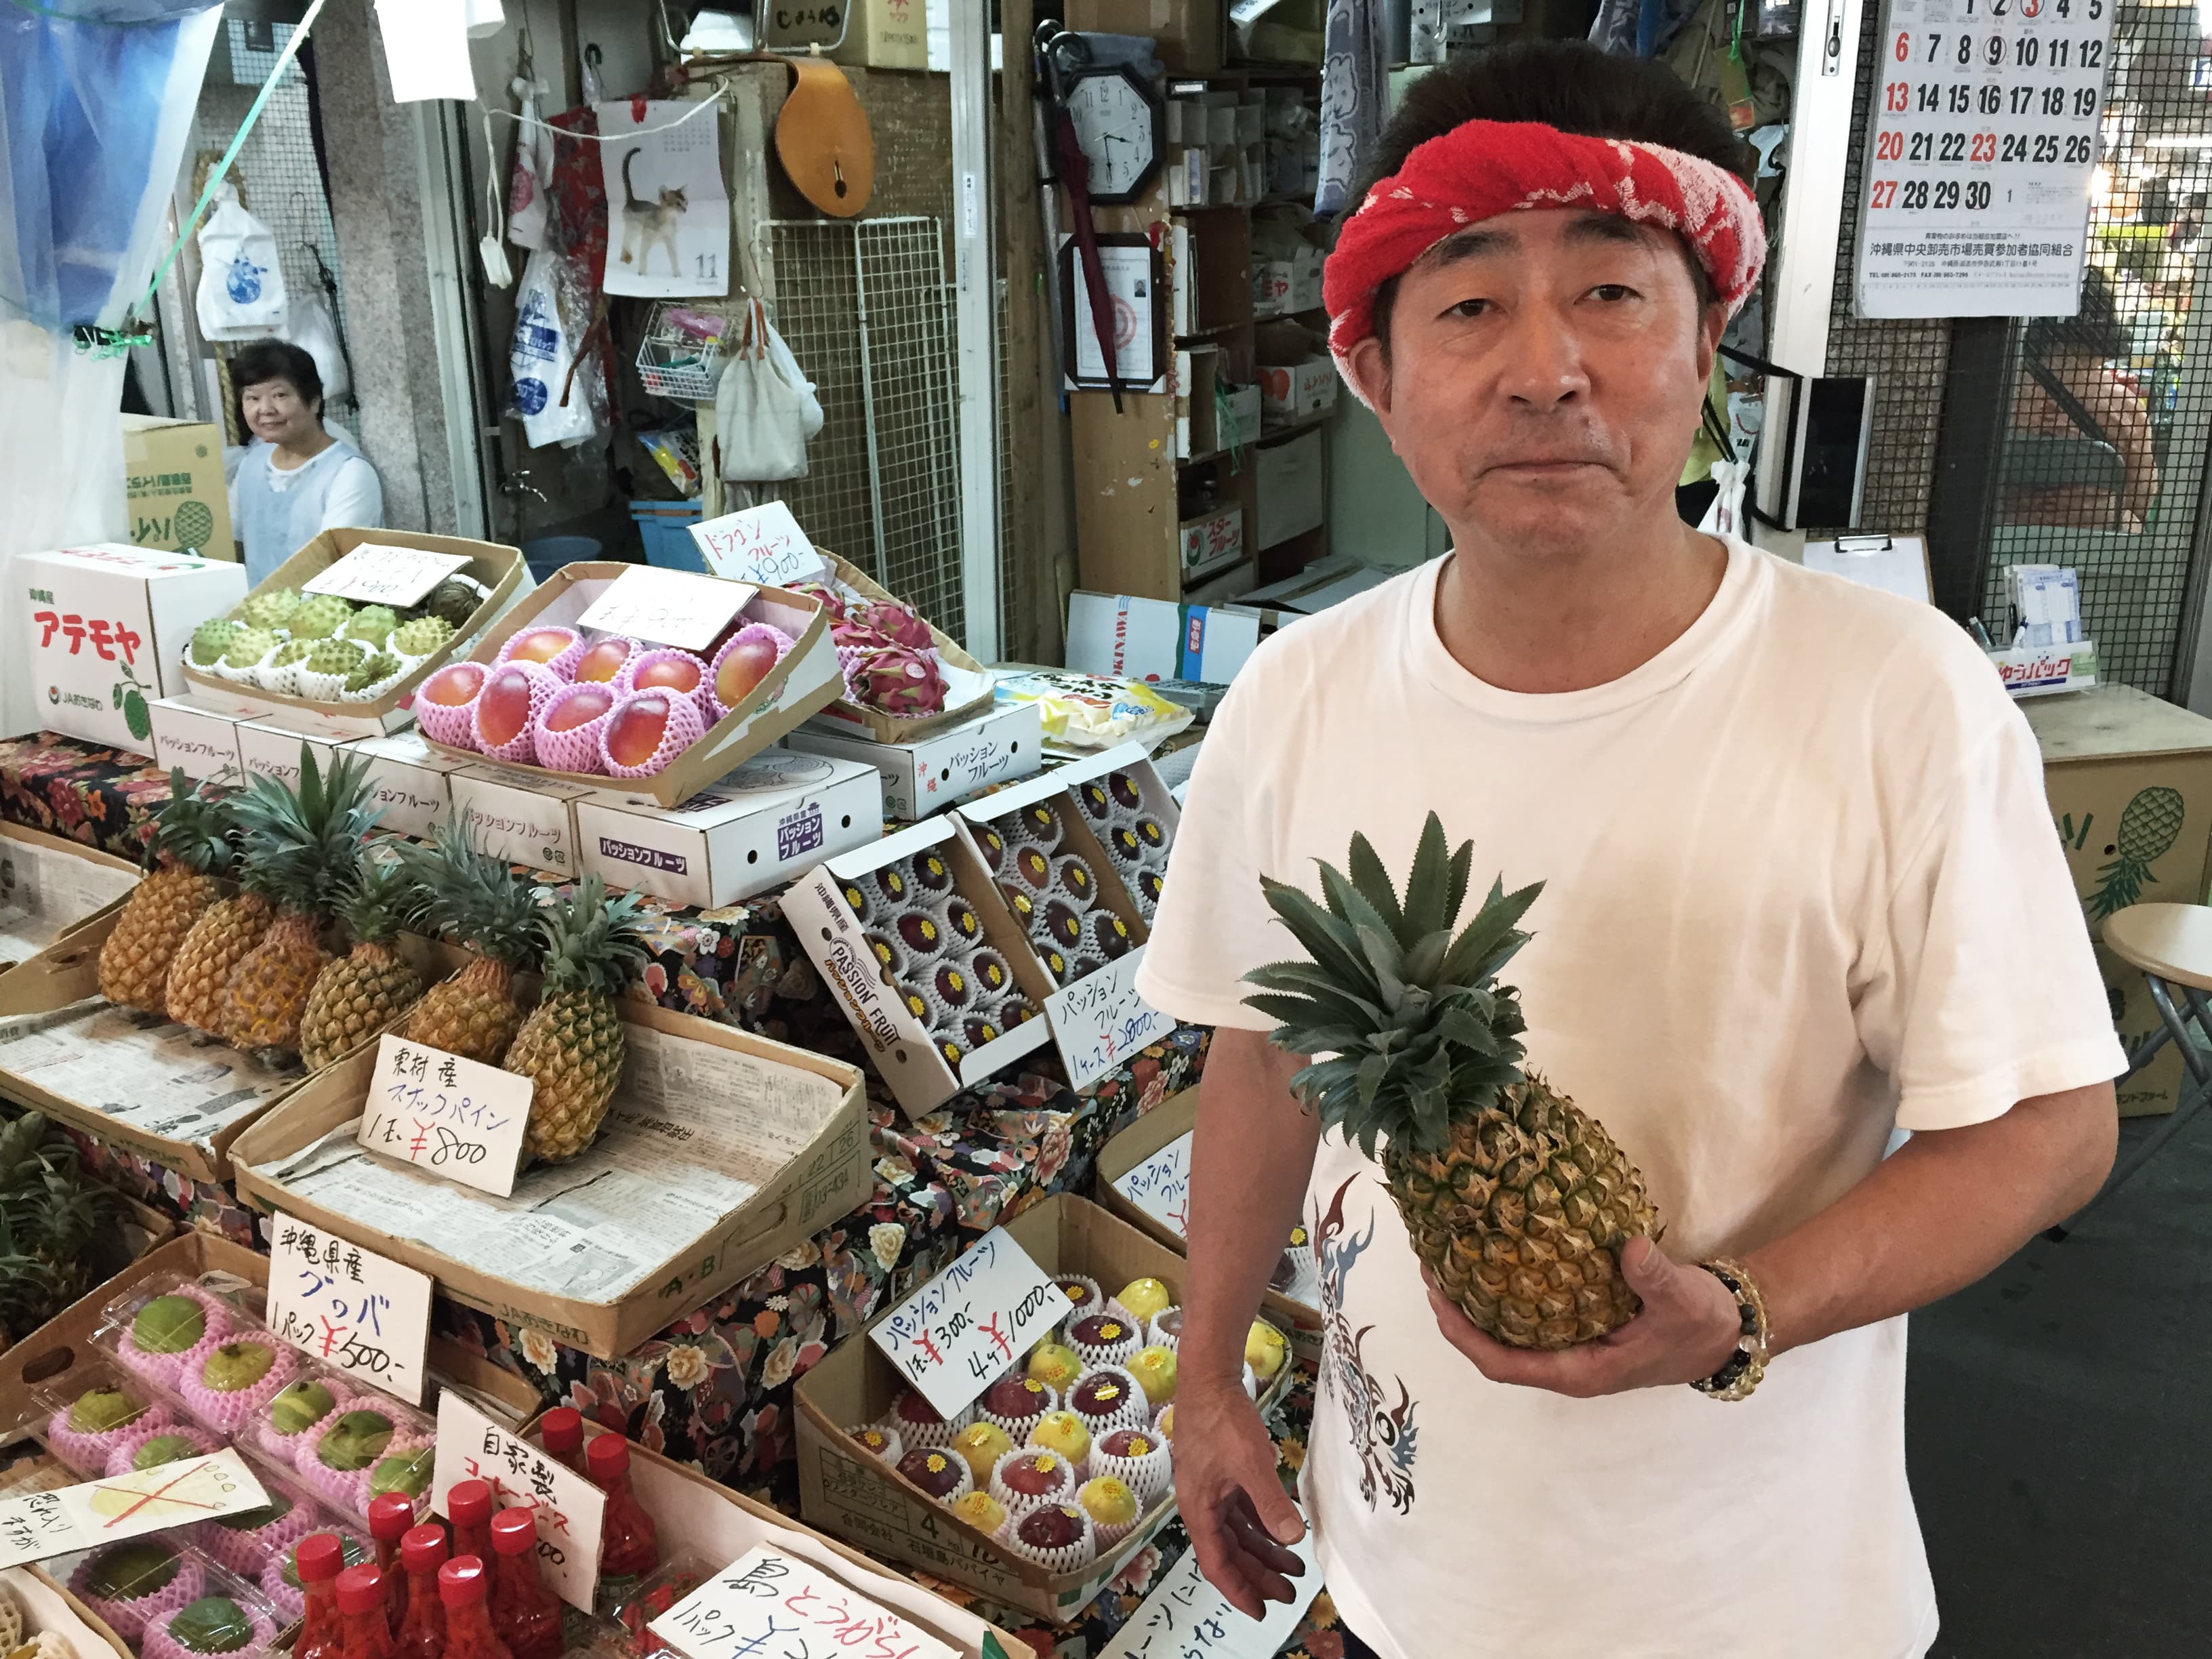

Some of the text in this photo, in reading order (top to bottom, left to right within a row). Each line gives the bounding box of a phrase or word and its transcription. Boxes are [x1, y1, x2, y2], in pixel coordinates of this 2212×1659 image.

[1896, 32, 2103, 68] 6 7 8 9 10 11 12
[1887, 82, 2097, 116] 13 14 15 16 17 18 19
[1877, 131, 2091, 163] 20 21 22 23 24 25 26
[1871, 180, 1898, 209] 27
[1902, 180, 1929, 209] 28
[1933, 181, 1960, 209] 29
[1965, 181, 1991, 210] 30
[1869, 243, 2074, 257] 沖縄県中央卸売市場売買参加者協同組合
[695, 253, 718, 279] 11
[1208, 518, 1231, 537] スター
[1208, 527, 1240, 556] フルーツ
[34, 611, 142, 665] アテモヤ
[1999, 657, 2072, 682] ゆうパック
[160, 735, 235, 761] パッションフルーツ
[949, 741, 998, 770] パッション
[968, 754, 1010, 783] フルーツ
[779, 817, 820, 844] パッション
[780, 832, 821, 856] フルーツ
[600, 840, 687, 875] パッションフルーツ
[832, 945, 879, 1005] PASSION
[869, 1006, 902, 1046] FRUIT
[1062, 968, 1118, 1025] パッション
[387, 1084, 510, 1131] スナックパイン
[409, 1116, 487, 1166] ¥800
[1126, 1149, 1180, 1203] パッション
[280, 1225, 365, 1284] 沖縄県産
[886, 1240, 996, 1351] パッションフルーツ
[920, 1512, 940, 1538] 4
